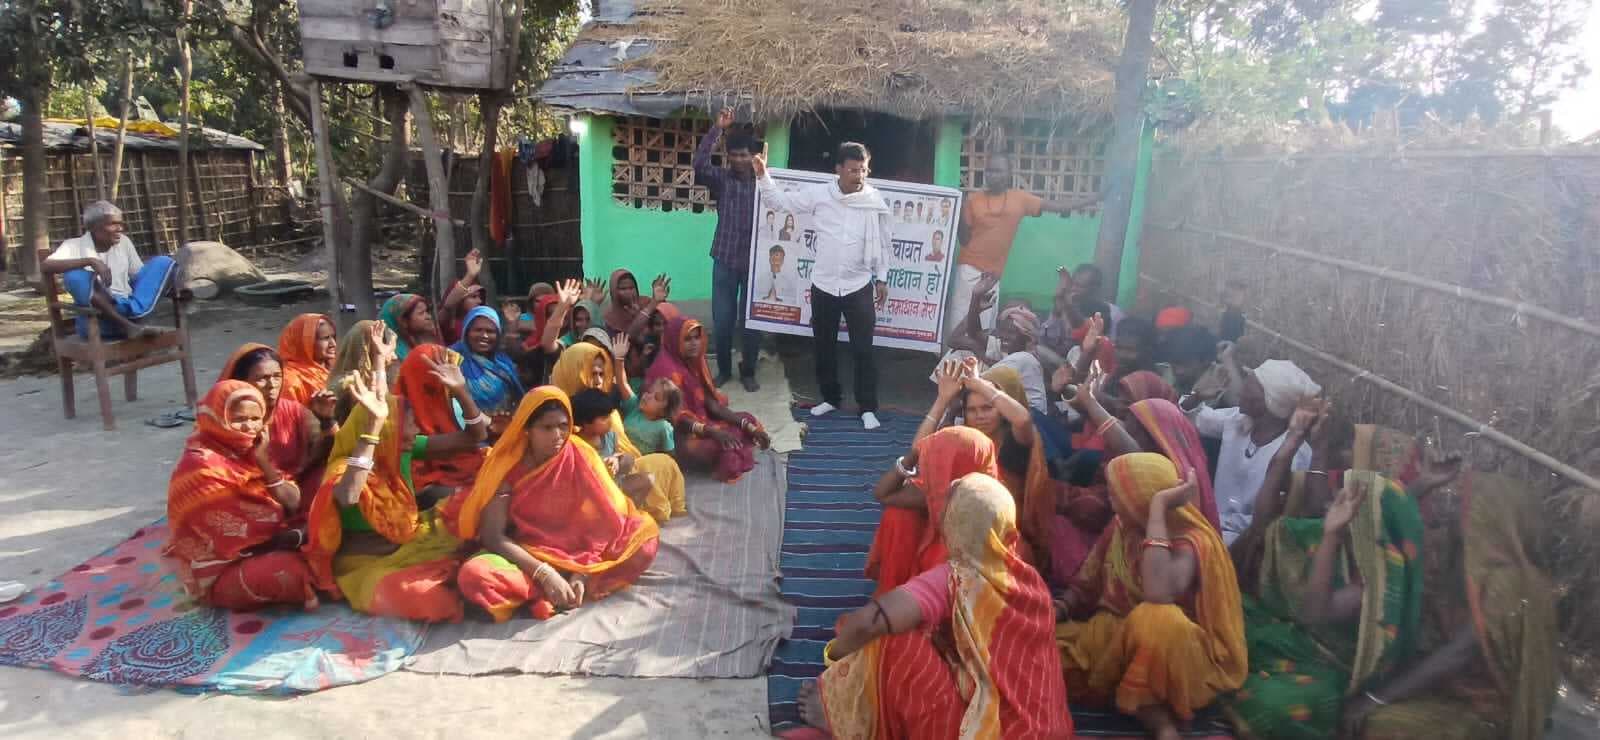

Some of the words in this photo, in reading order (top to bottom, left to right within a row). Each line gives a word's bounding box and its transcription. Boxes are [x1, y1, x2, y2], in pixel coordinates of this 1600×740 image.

[887, 267, 924, 290] माधान
[927, 264, 942, 295] हो
[888, 297, 921, 317] समाधान
